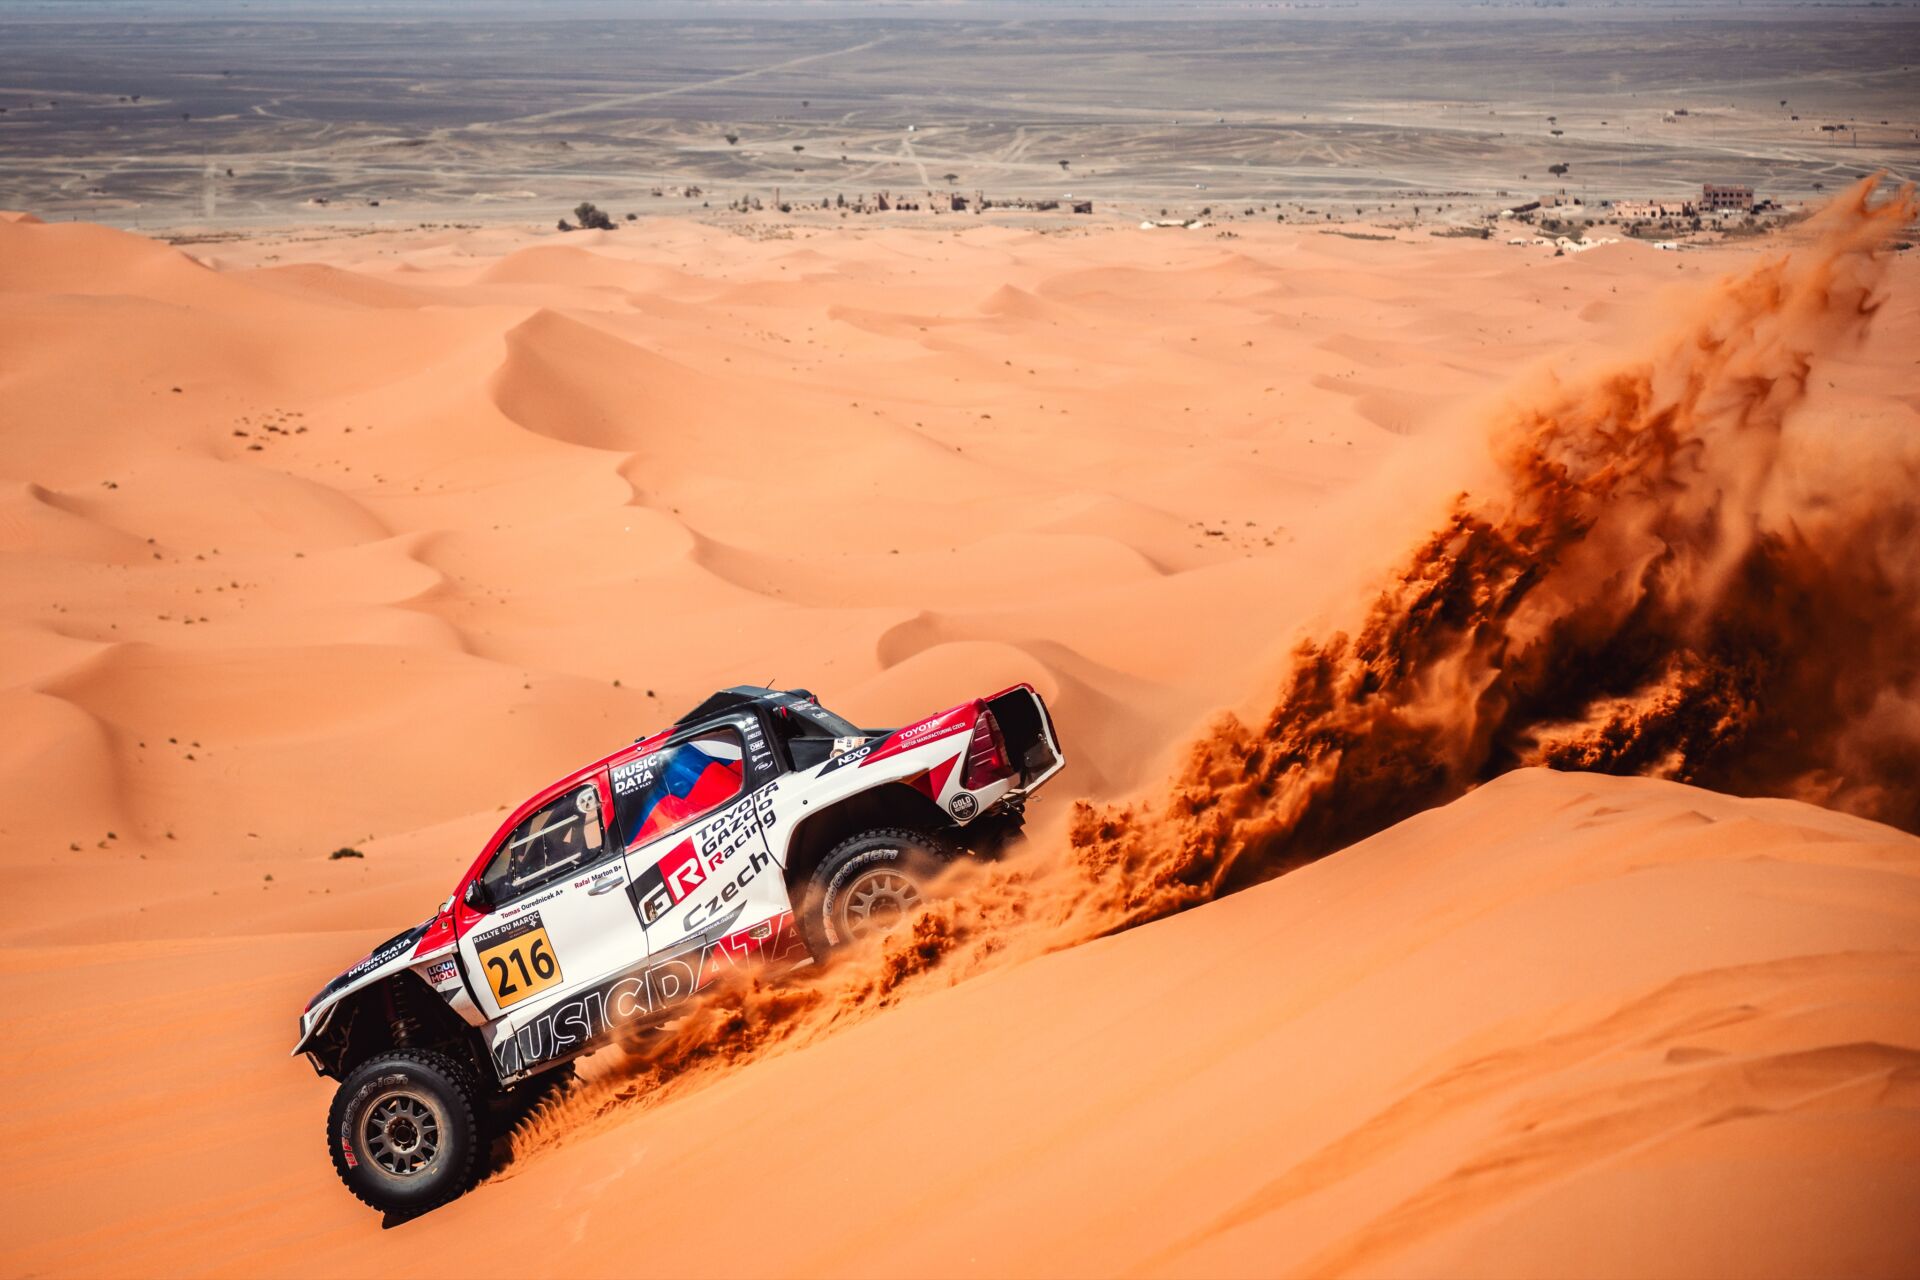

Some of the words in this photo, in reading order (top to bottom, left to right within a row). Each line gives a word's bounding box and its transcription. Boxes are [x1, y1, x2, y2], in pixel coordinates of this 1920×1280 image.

[899, 719, 940, 740] TOYOTA
[613, 754, 658, 782] MUSIC
[837, 746, 871, 767] NEXO
[614, 770, 654, 794] DATA
[695, 782, 780, 841] TOYOTA
[952, 796, 972, 809] GOLD
[701, 798, 773, 857] GAZOO
[707, 809, 777, 872] Racing
[574, 878, 591, 889] Rafal
[591, 868, 613, 882] Marton
[613, 864, 622, 874] B+
[500, 907, 521, 919] Tomas
[520, 891, 555, 912] Ourednicek
[555, 888, 564, 898] A+
[638, 857, 704, 926] GR
[682, 851, 769, 932] Czech
[473, 928, 500, 945] RALLYE
[500, 923, 512, 933] DU
[512, 911, 540, 928] MAROC
[348, 938, 412, 978] MUSICDATA
[363, 961, 379, 973] PLUG
[383, 951, 399, 963] PLAY
[428, 961, 455, 976] LIQUI
[487, 938, 555, 998] 216
[430, 968, 457, 984] MOLY
